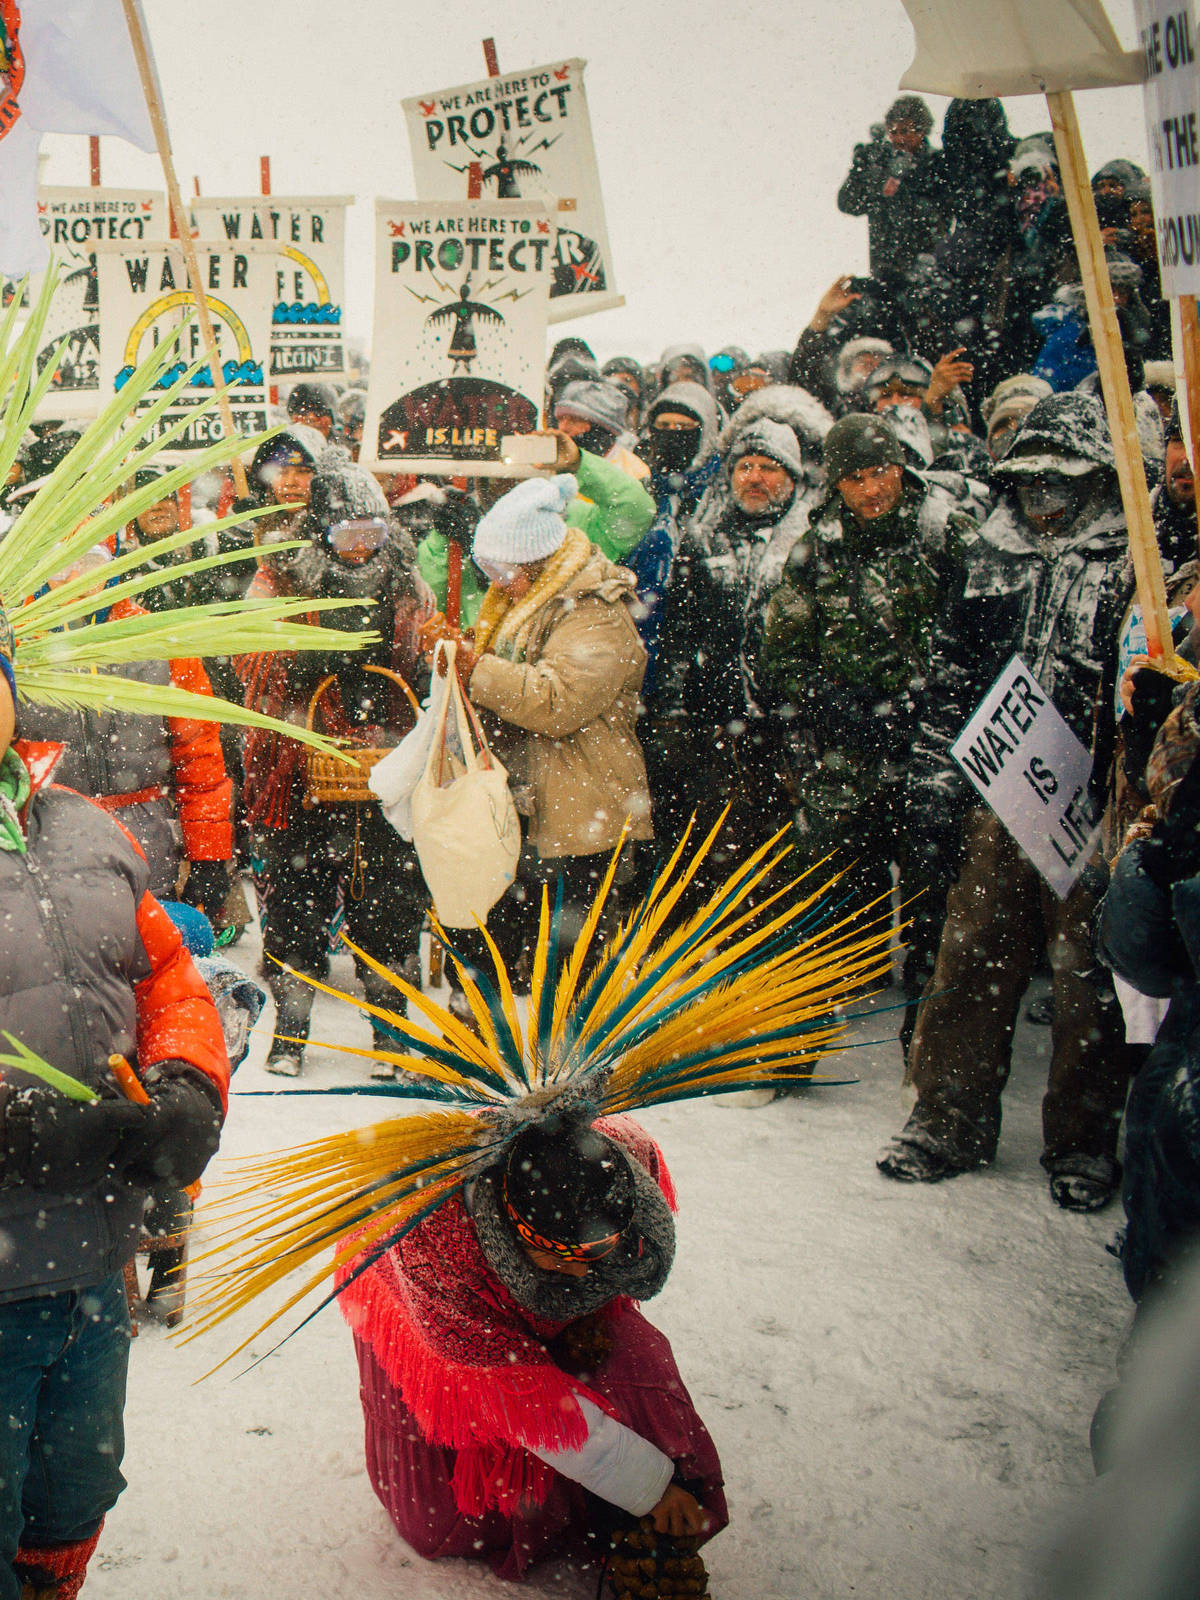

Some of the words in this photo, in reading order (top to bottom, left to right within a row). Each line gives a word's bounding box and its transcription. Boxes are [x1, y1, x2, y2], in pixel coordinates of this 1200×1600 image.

[1165, 10, 1195, 70] OIL
[440, 96, 462, 112] WE
[465, 88, 492, 107] ARE
[495, 78, 528, 98] HERE
[531, 72, 550, 88] TO
[425, 84, 571, 151] PROTECT
[1162, 112, 1198, 169] THE
[52, 203, 66, 214] WE
[70, 202, 90, 213] ARE
[93, 201, 120, 213] HERE
[122, 202, 136, 213] TO
[409, 220, 432, 234] WE
[435, 218, 464, 233] ARE
[468, 217, 507, 233] HERE
[510, 219, 531, 233] TO
[222, 211, 324, 243] WATER
[392, 238, 549, 273] PROTECT
[403, 393, 535, 430] WATER
[426, 427, 446, 445] IS
[451, 426, 497, 446] LIFE
[962, 674, 1045, 788] WATER
[1023, 756, 1058, 805] IS
